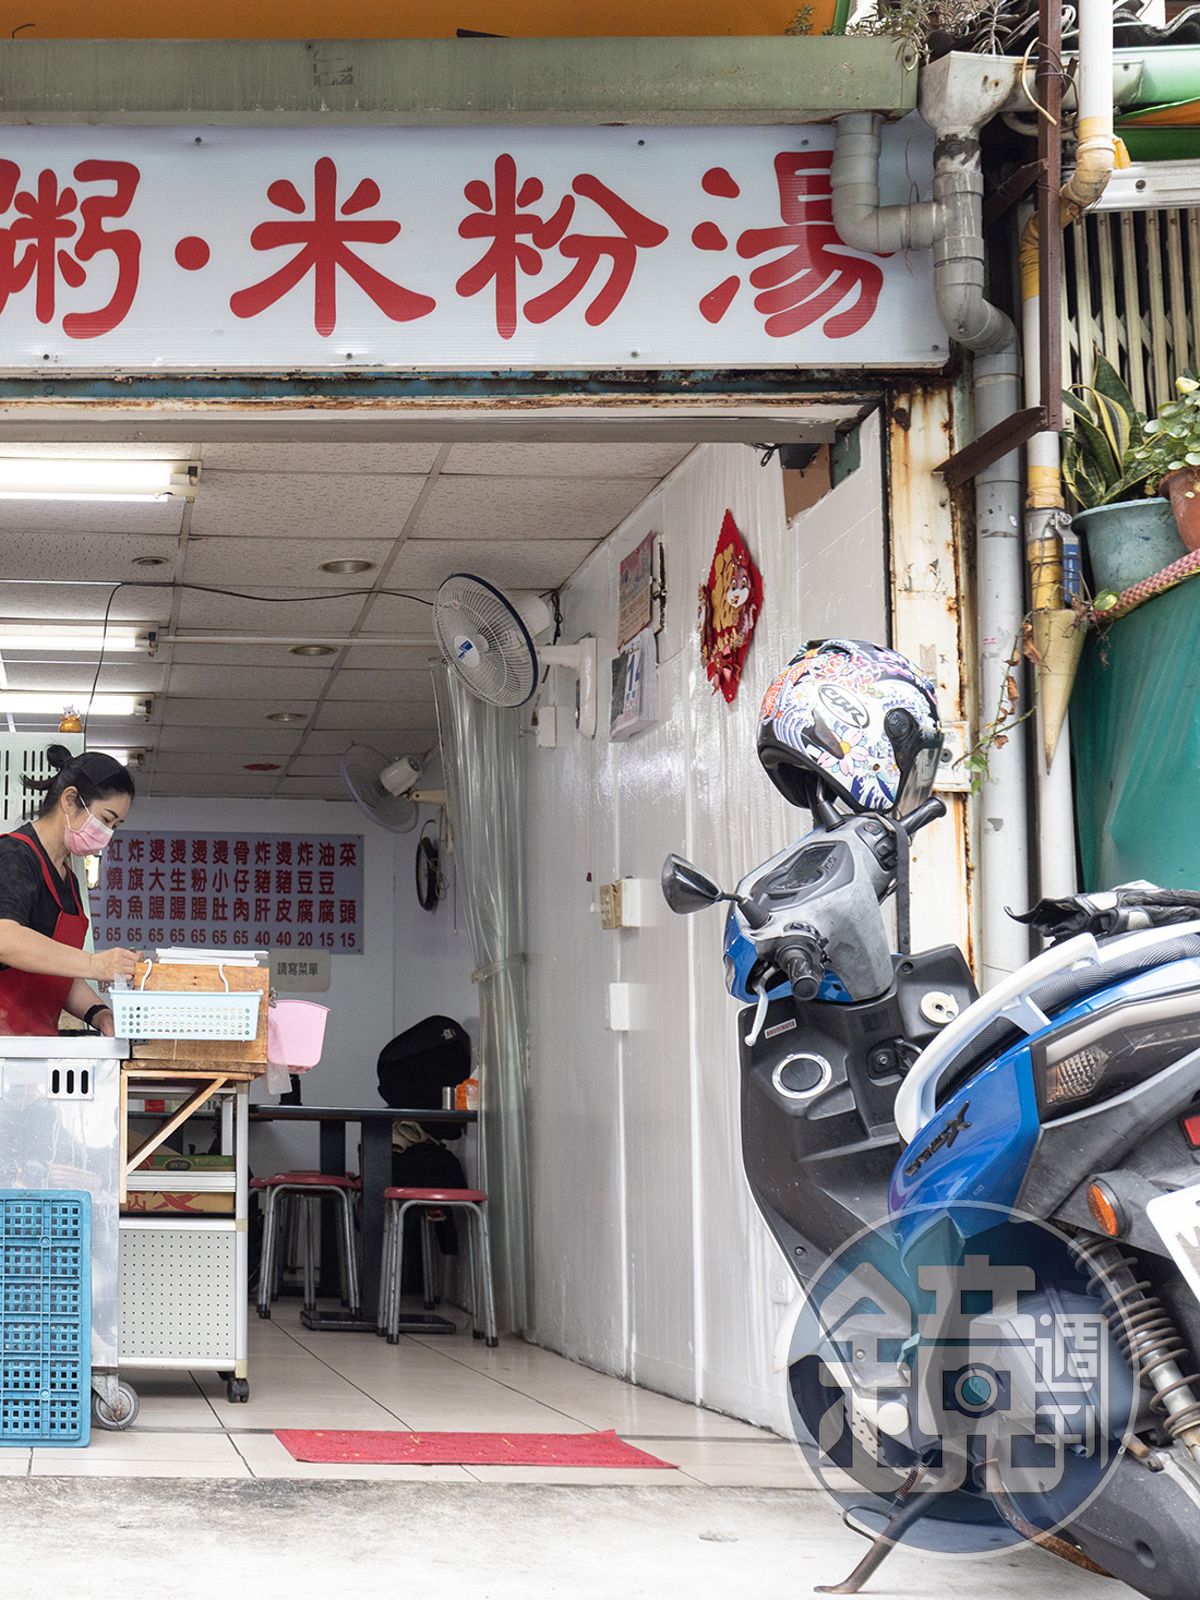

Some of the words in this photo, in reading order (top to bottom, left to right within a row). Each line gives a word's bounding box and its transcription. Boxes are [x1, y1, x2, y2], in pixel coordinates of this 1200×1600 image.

[106, 927, 121, 942] 65
[127, 928, 142, 942] 65
[150, 928, 164, 943] 65
[170, 928, 185, 943] 65
[191, 929, 206, 943] 65
[212, 929, 227, 944] 65
[233, 930, 249, 945] 65
[255, 931, 270, 946] 40
[276, 931, 292, 946] 40
[297, 932, 313, 946] 20
[319, 932, 334, 947] 15
[340, 933, 356, 947] 15
[277, 962, 319, 976] 請寫菜單
